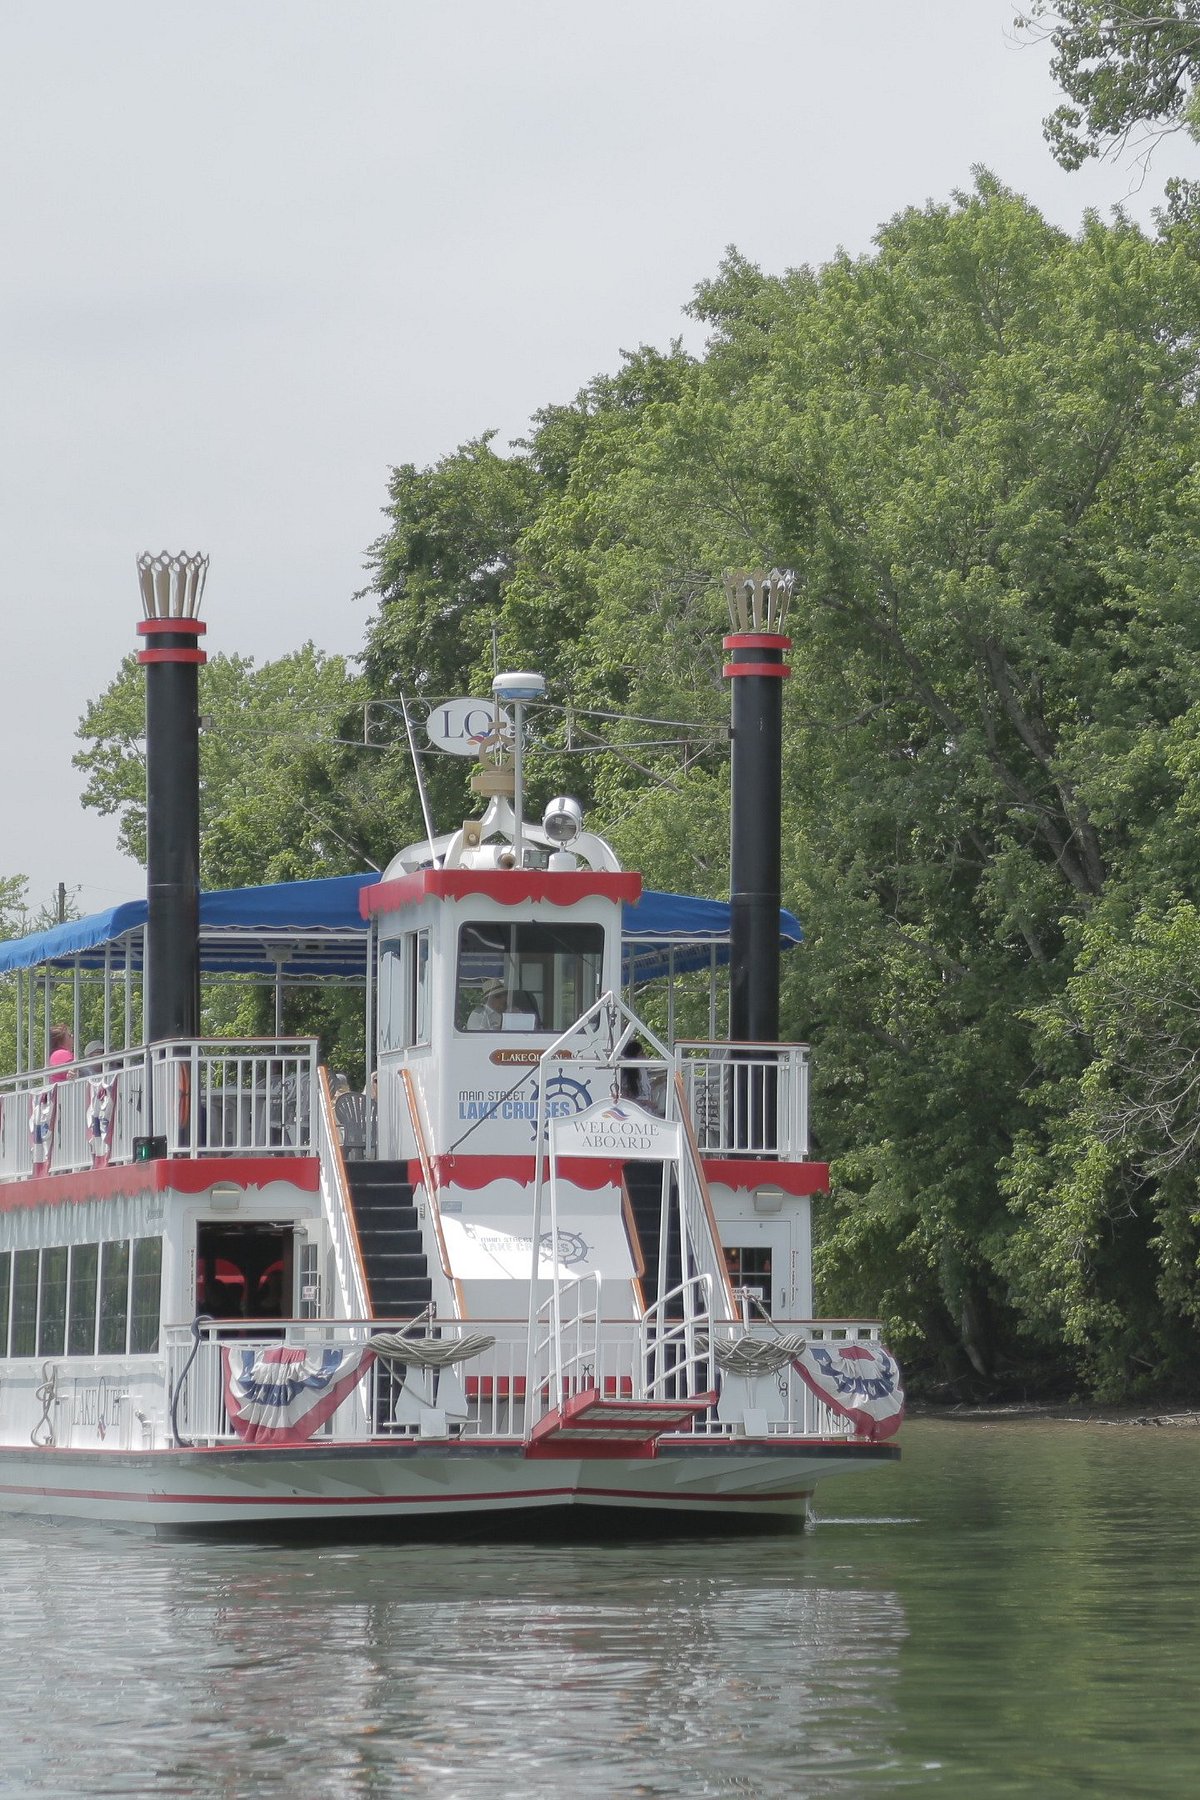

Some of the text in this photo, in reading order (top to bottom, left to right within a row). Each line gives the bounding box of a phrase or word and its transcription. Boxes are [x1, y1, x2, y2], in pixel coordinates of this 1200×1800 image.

[440, 709, 494, 740] LQ
[501, 1052, 527, 1062] LAKE
[459, 1090, 485, 1101] MAIN
[459, 1102, 498, 1120] LAKE
[573, 1121, 660, 1137] WELCOME
[582, 1135, 652, 1150] ABOARD
[72, 1377, 97, 1426] LAKE
